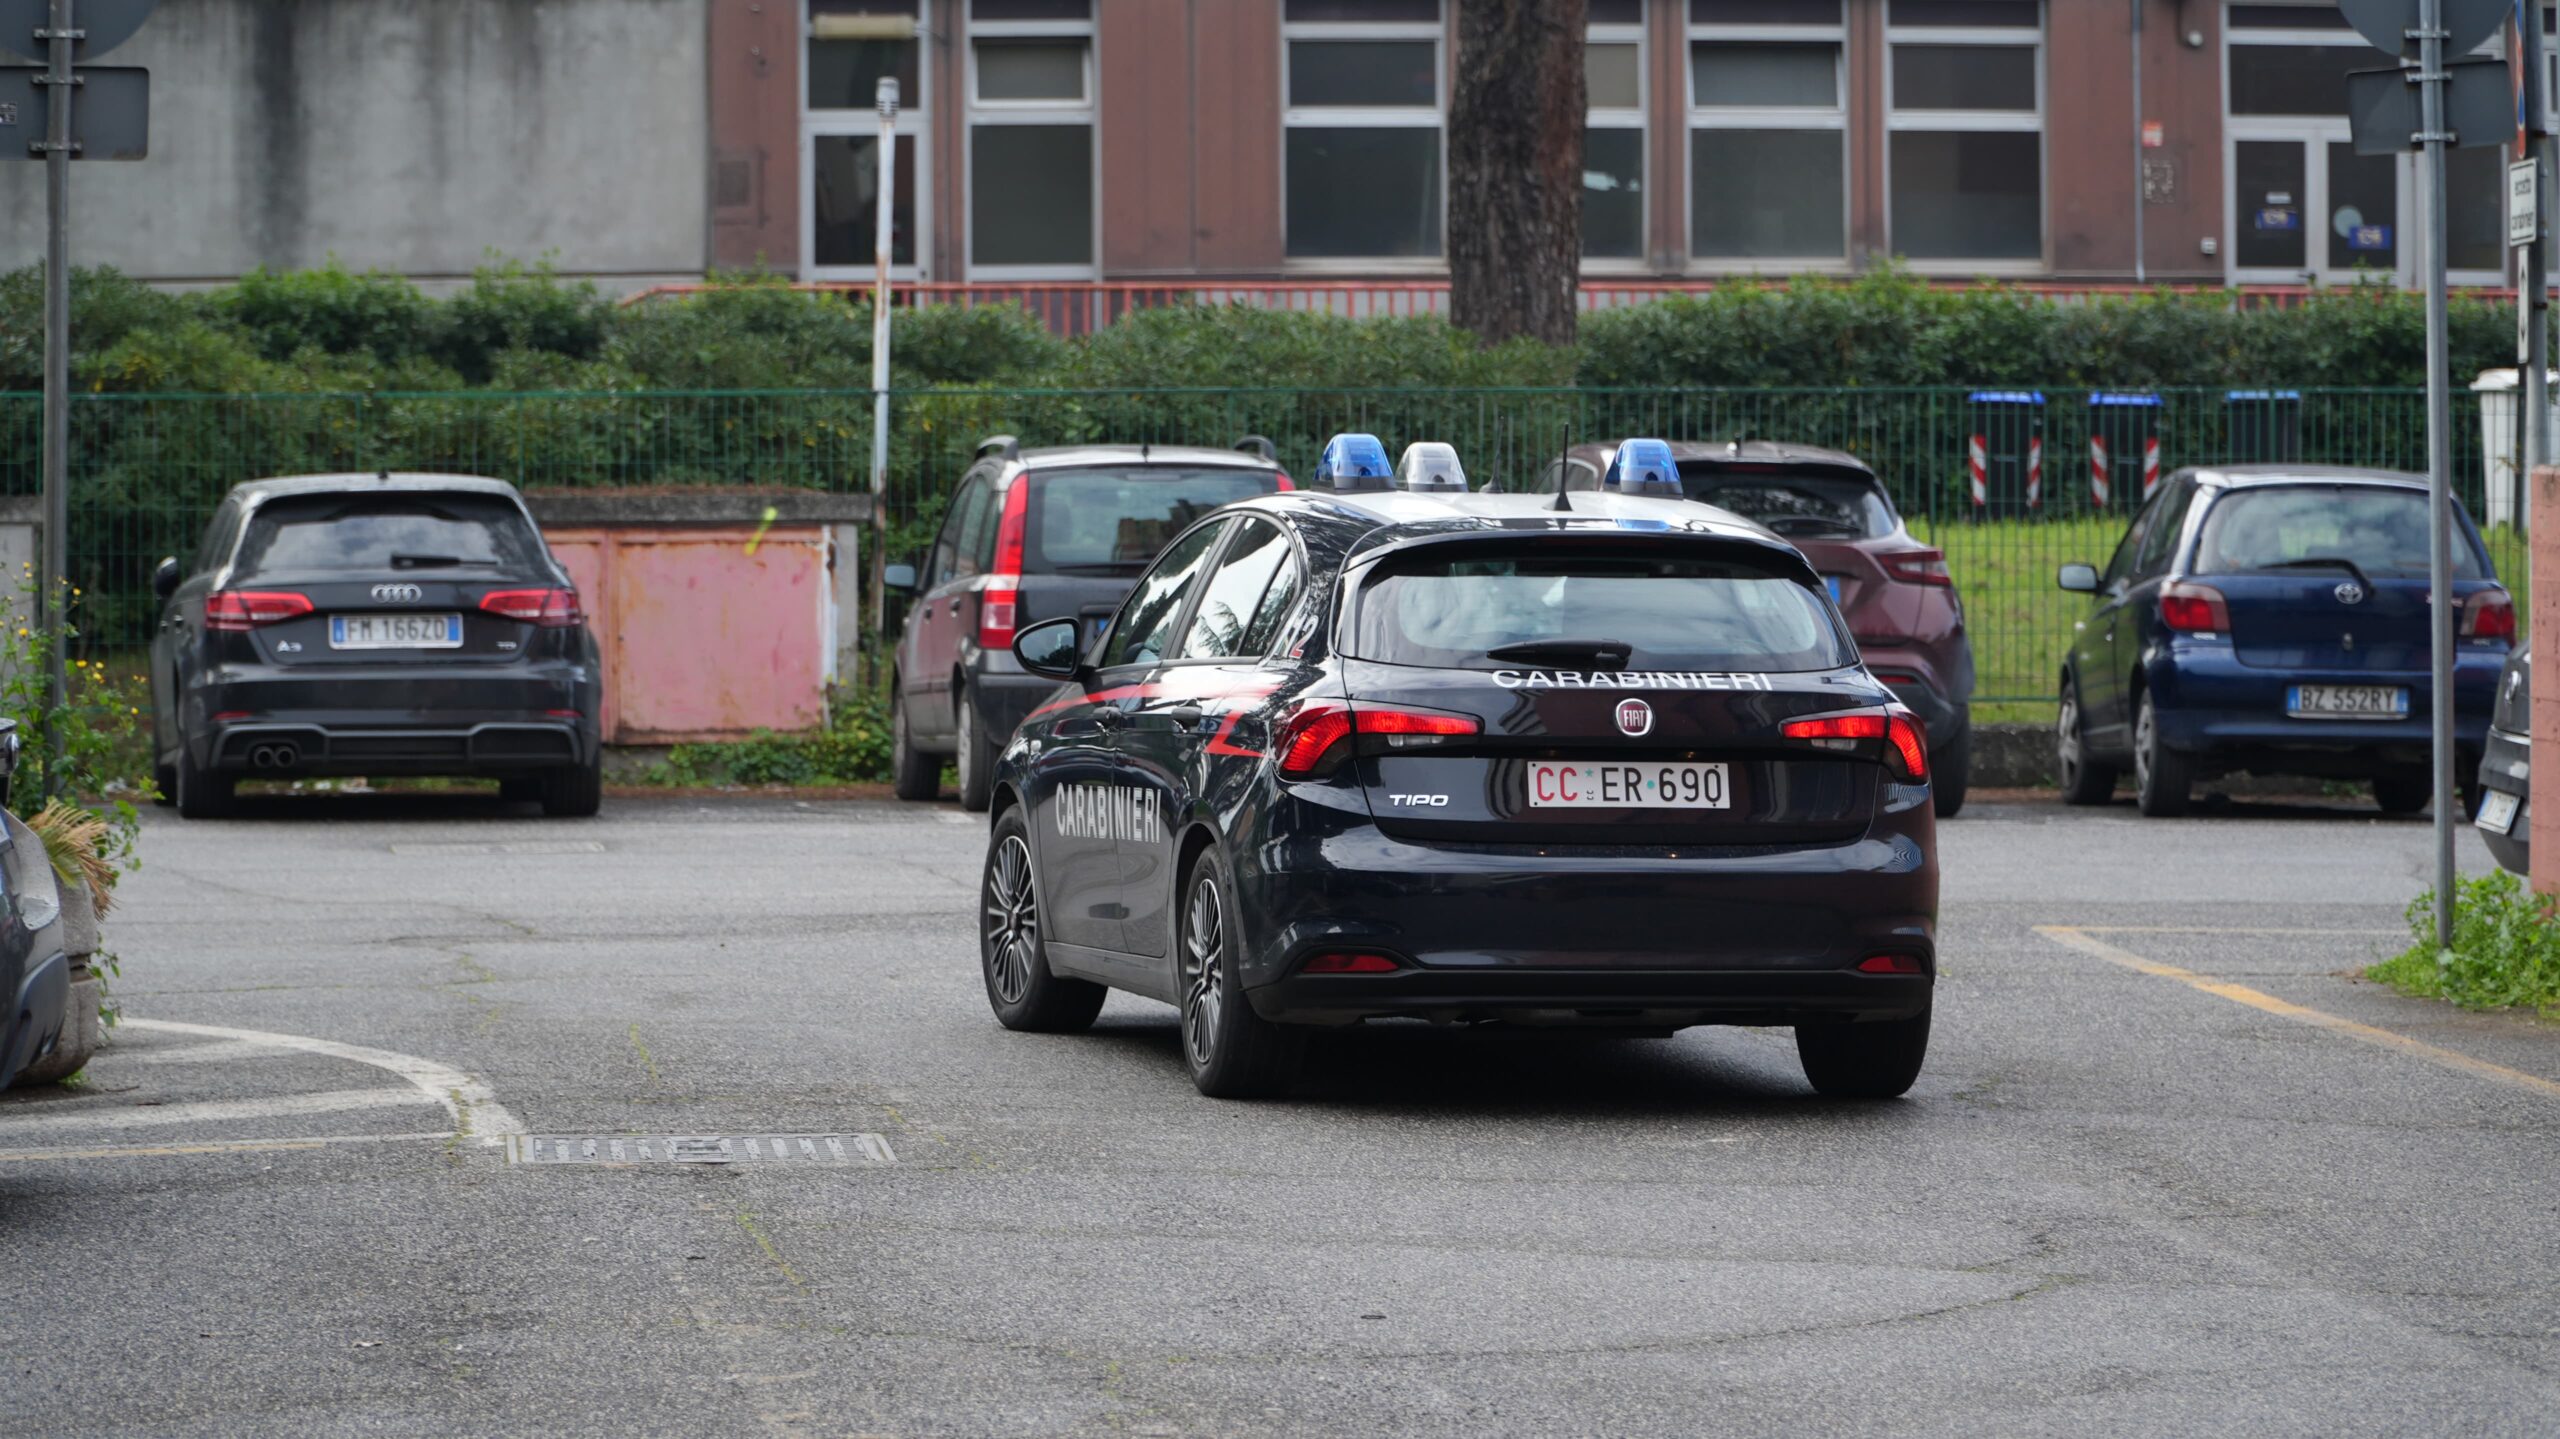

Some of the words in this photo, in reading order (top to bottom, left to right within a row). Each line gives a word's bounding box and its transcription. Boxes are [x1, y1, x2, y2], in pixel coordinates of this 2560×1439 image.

[349, 616, 373, 641] FM
[383, 616, 446, 641] 166ZD
[1491, 670, 1774, 691] CARABINIERI
[2302, 688, 2326, 710] BZ
[2333, 687, 2395, 711] 552RY
[1623, 709, 1646, 728] FIAT
[1536, 766, 1578, 802] CC
[1601, 767, 1643, 802] ER
[1658, 768, 1722, 802] 690
[1389, 794, 1449, 807] TIPO
[1055, 782, 1162, 844] CARABINIERI
